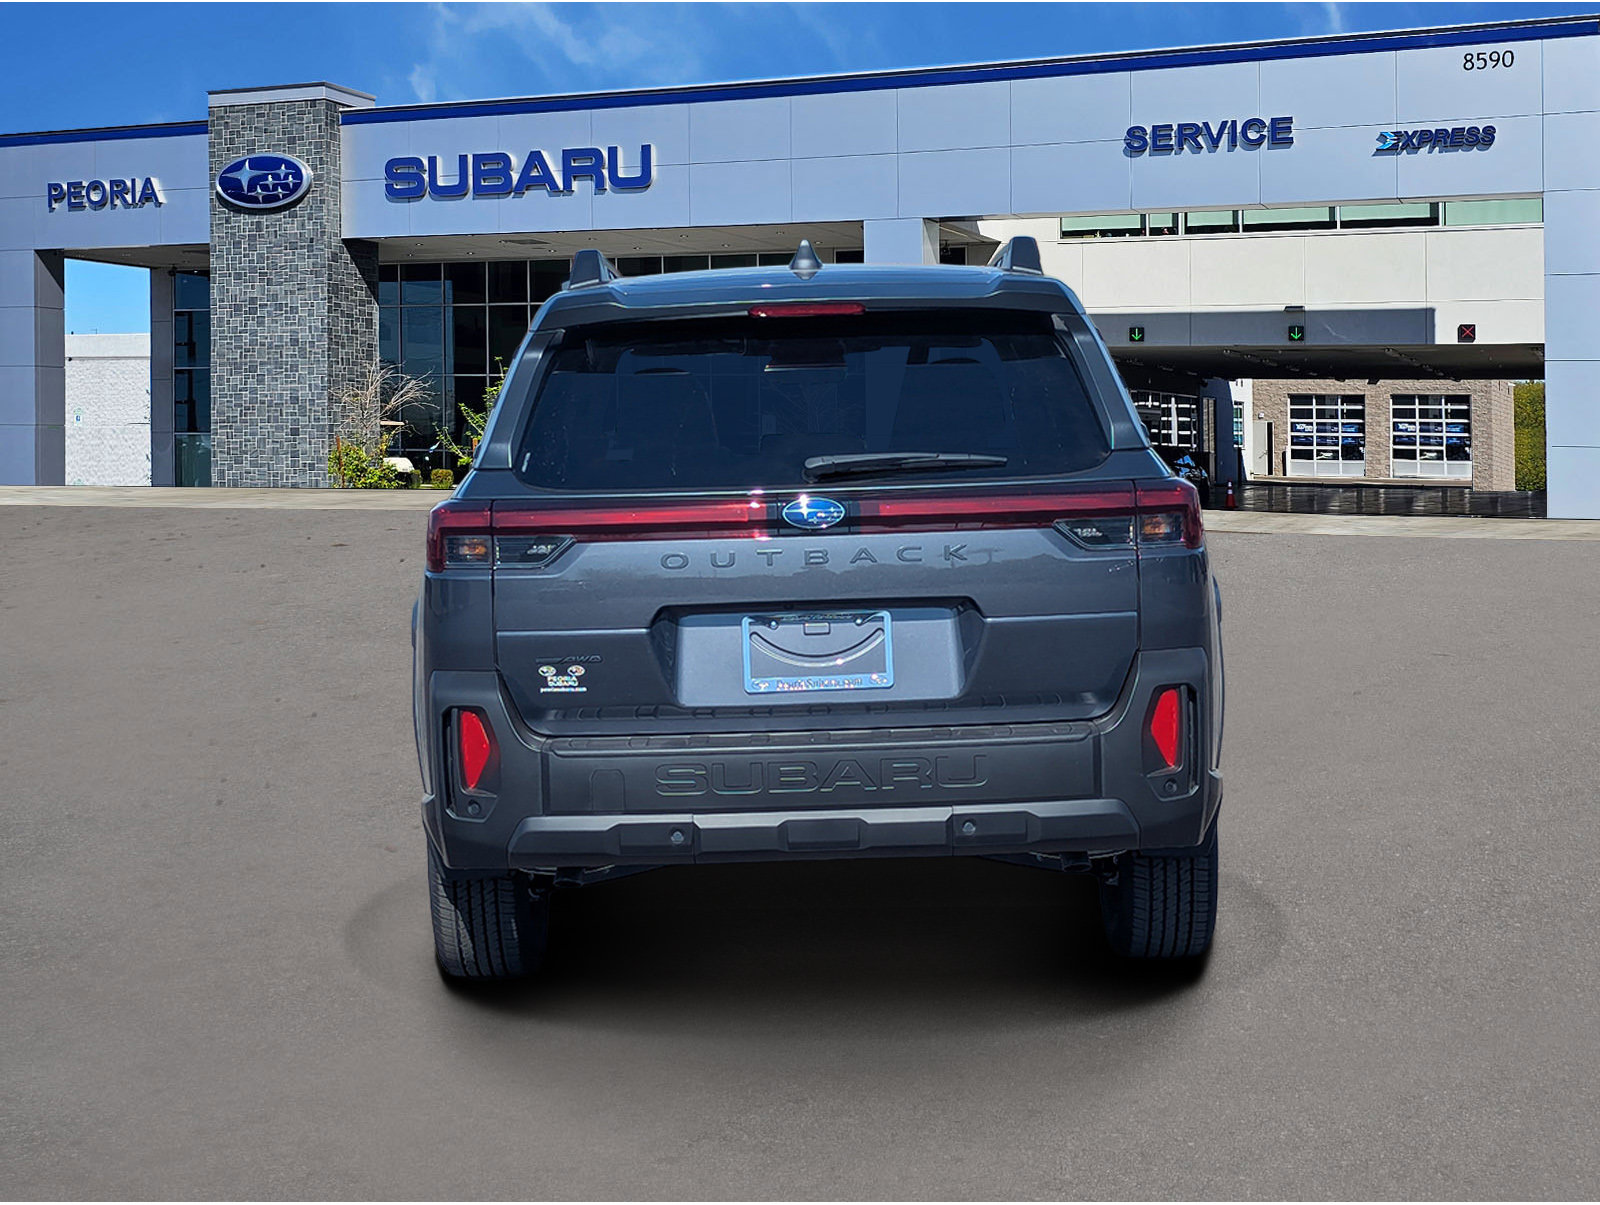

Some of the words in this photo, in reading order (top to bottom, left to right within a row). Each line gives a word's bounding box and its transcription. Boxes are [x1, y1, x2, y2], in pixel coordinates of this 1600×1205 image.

[1463, 50, 1514, 71] 8590
[1125, 116, 1294, 155] SERVICE
[1375, 125, 1496, 153] EXPRESS
[385, 143, 653, 200] SUBARU
[48, 176, 163, 210] PEORIA
[660, 542, 971, 571] OUTBACK
[654, 754, 988, 797] SUBARU
